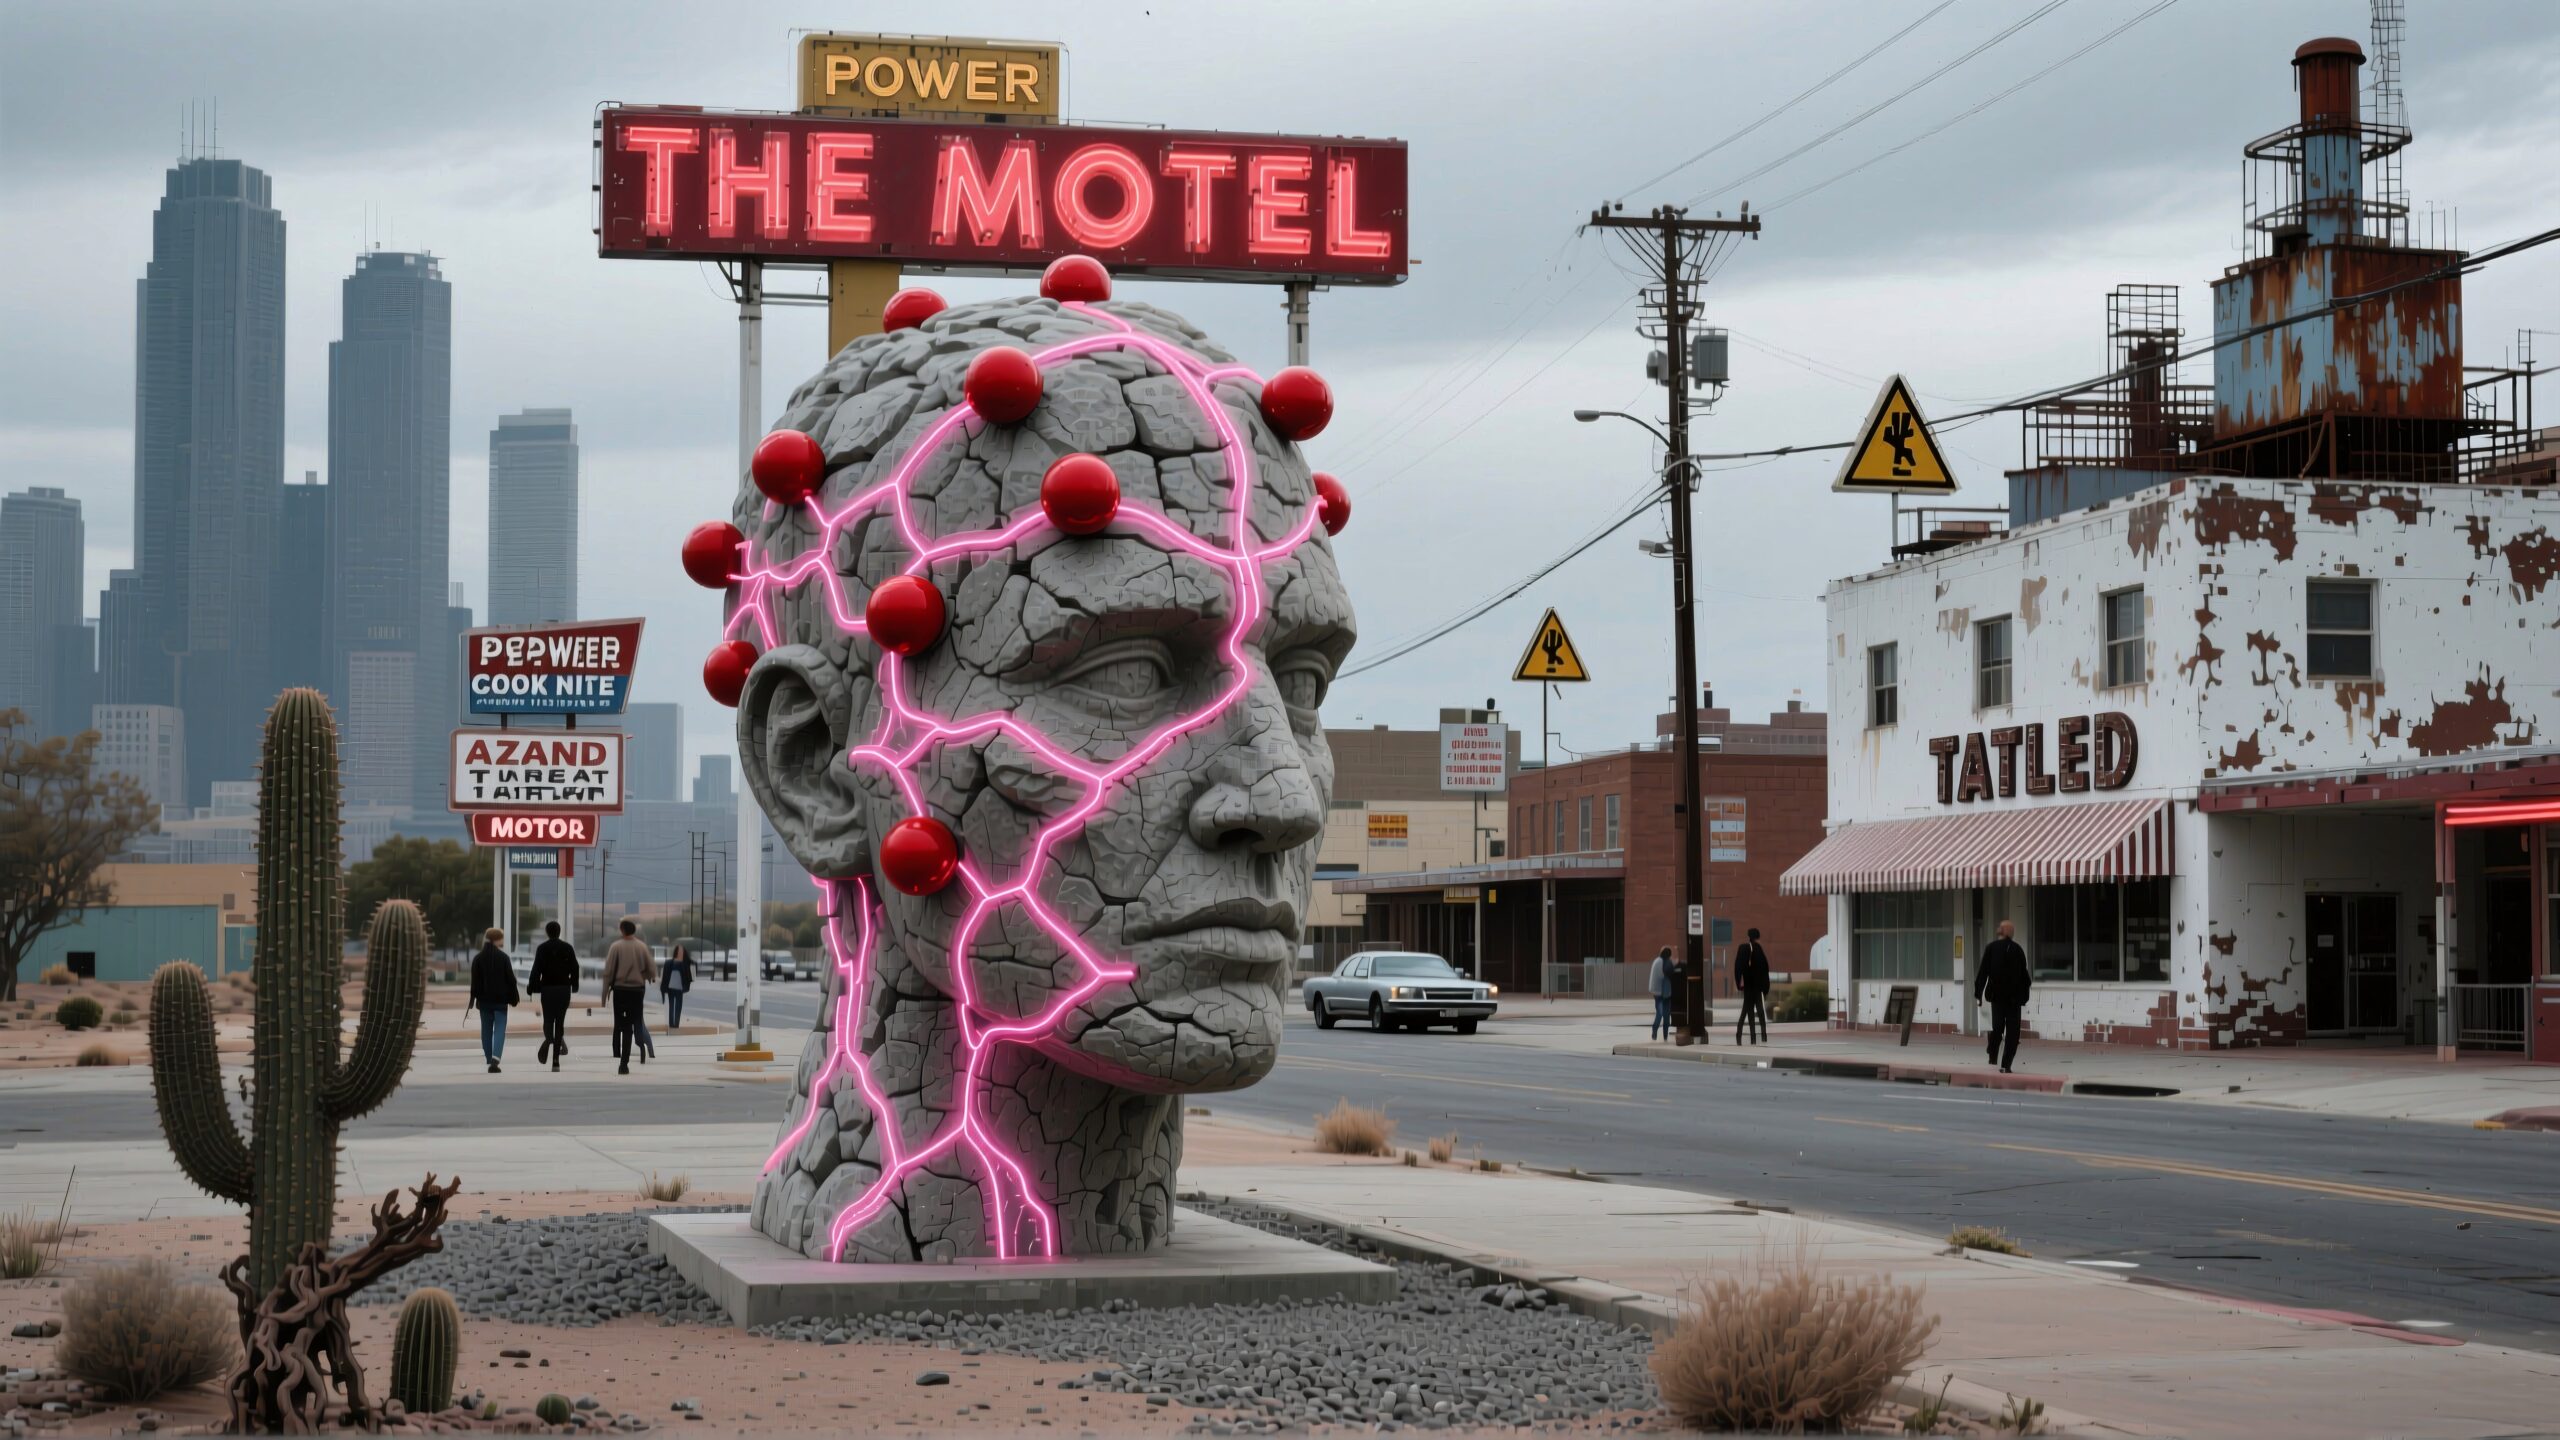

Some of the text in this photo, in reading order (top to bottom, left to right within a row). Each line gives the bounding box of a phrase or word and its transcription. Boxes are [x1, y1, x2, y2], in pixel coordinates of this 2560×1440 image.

[825, 53, 1040, 104] POWER
[625, 125, 1393, 259] THE MOTEL
[471, 673, 615, 696] COOK NITE
[465, 739, 607, 766] AZAND
[1929, 711, 2139, 804] TATLED
[491, 816, 586, 839] MOTOR
